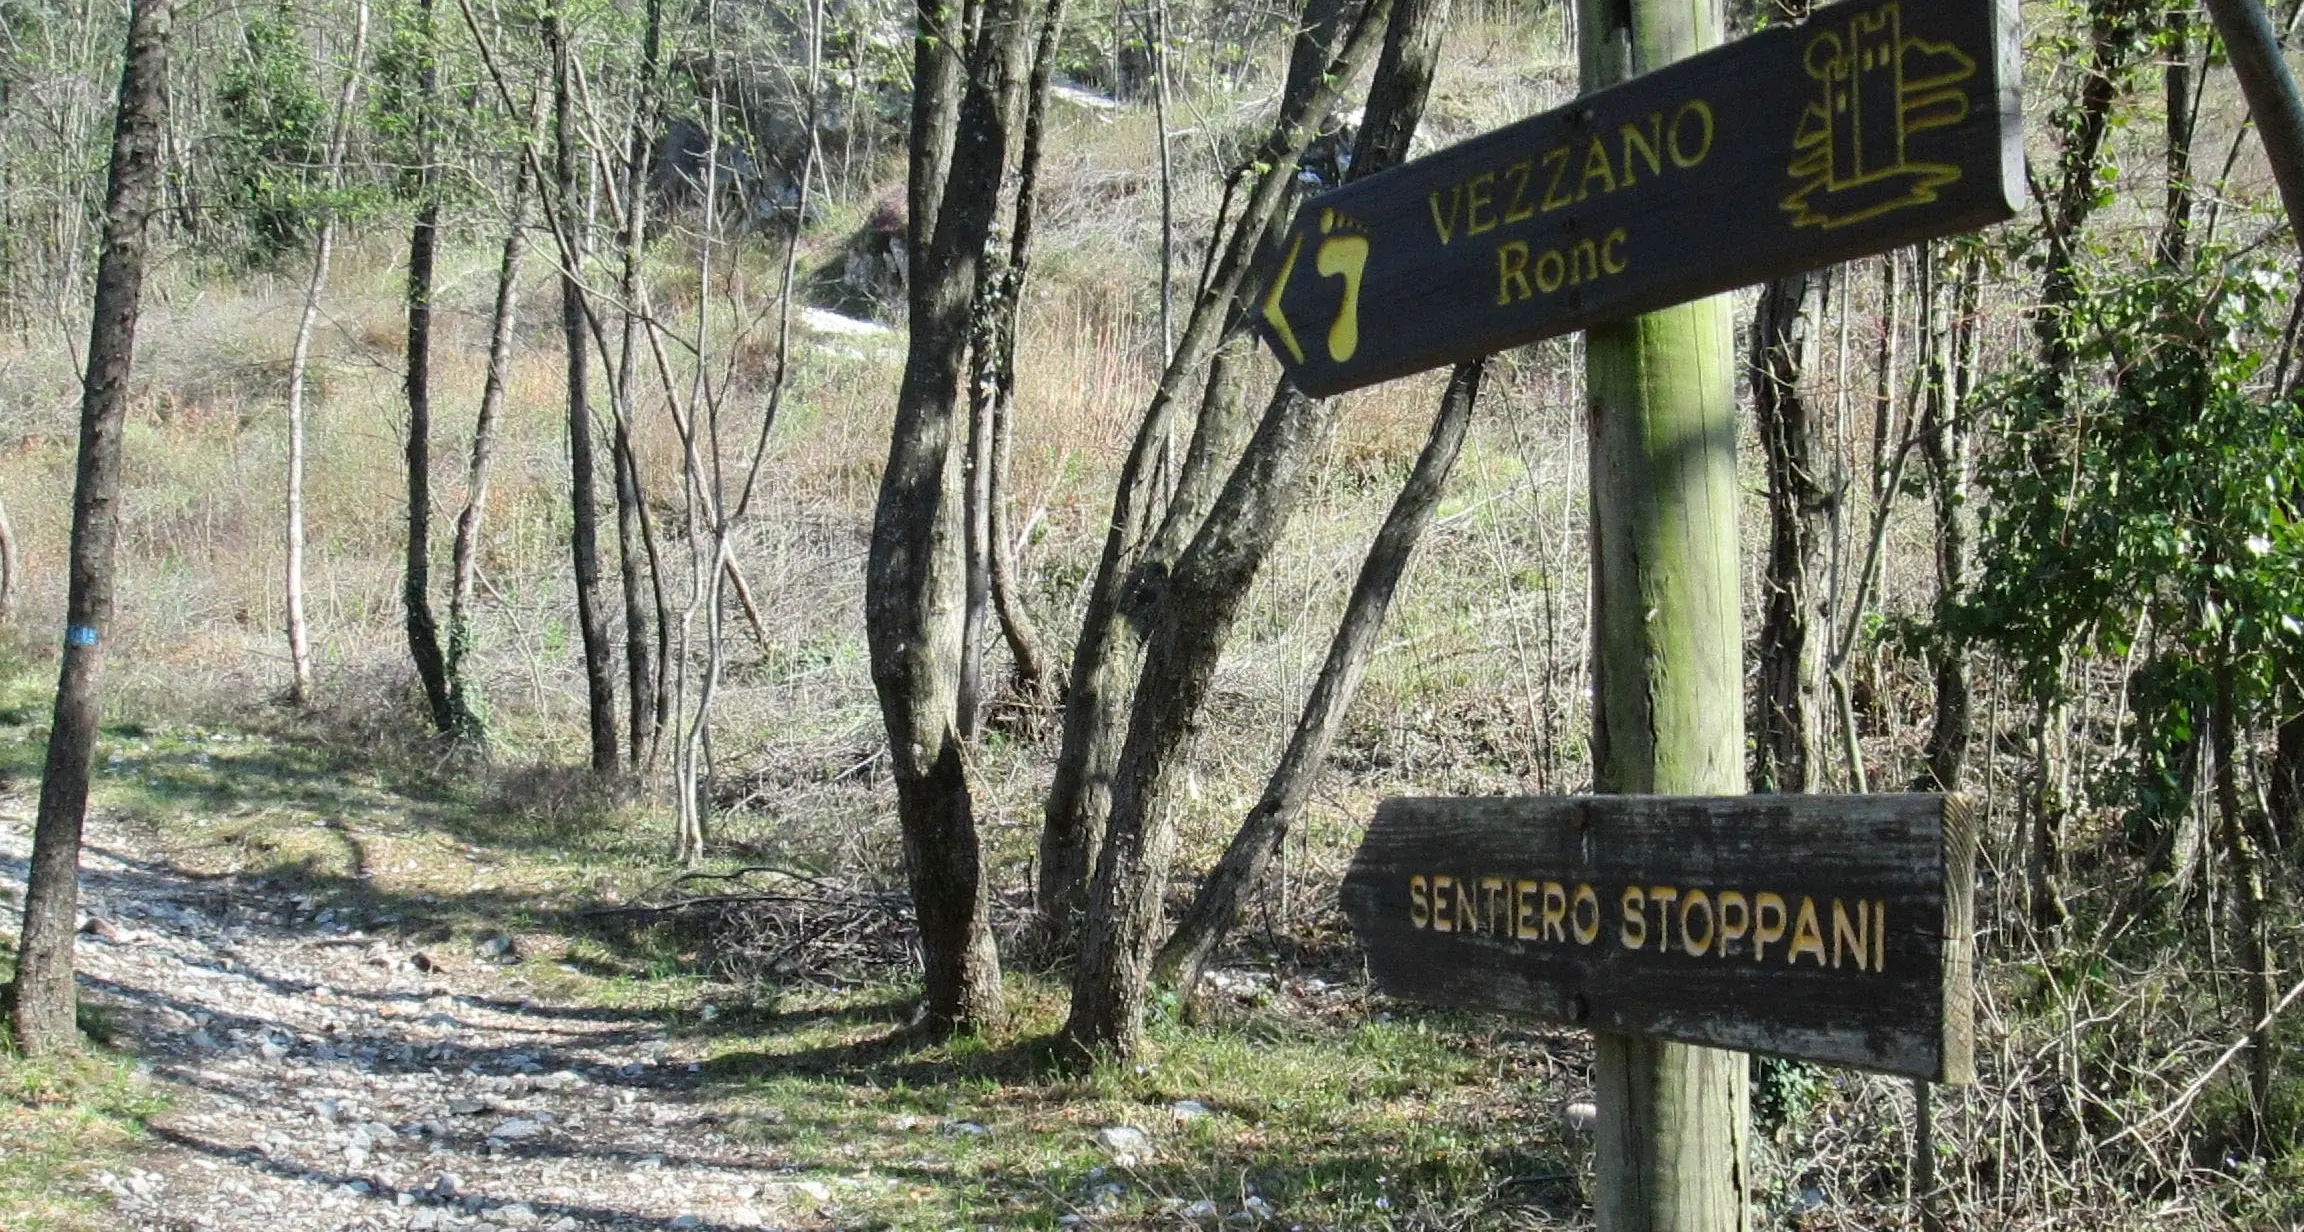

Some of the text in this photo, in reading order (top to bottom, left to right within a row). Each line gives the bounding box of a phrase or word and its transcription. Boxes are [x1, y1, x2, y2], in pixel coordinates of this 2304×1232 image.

[1430, 99, 1714, 245] VEZZANO
[1496, 228, 1628, 305] Ronc
[1409, 875, 1885, 972] SENTIERO STOPPANI
